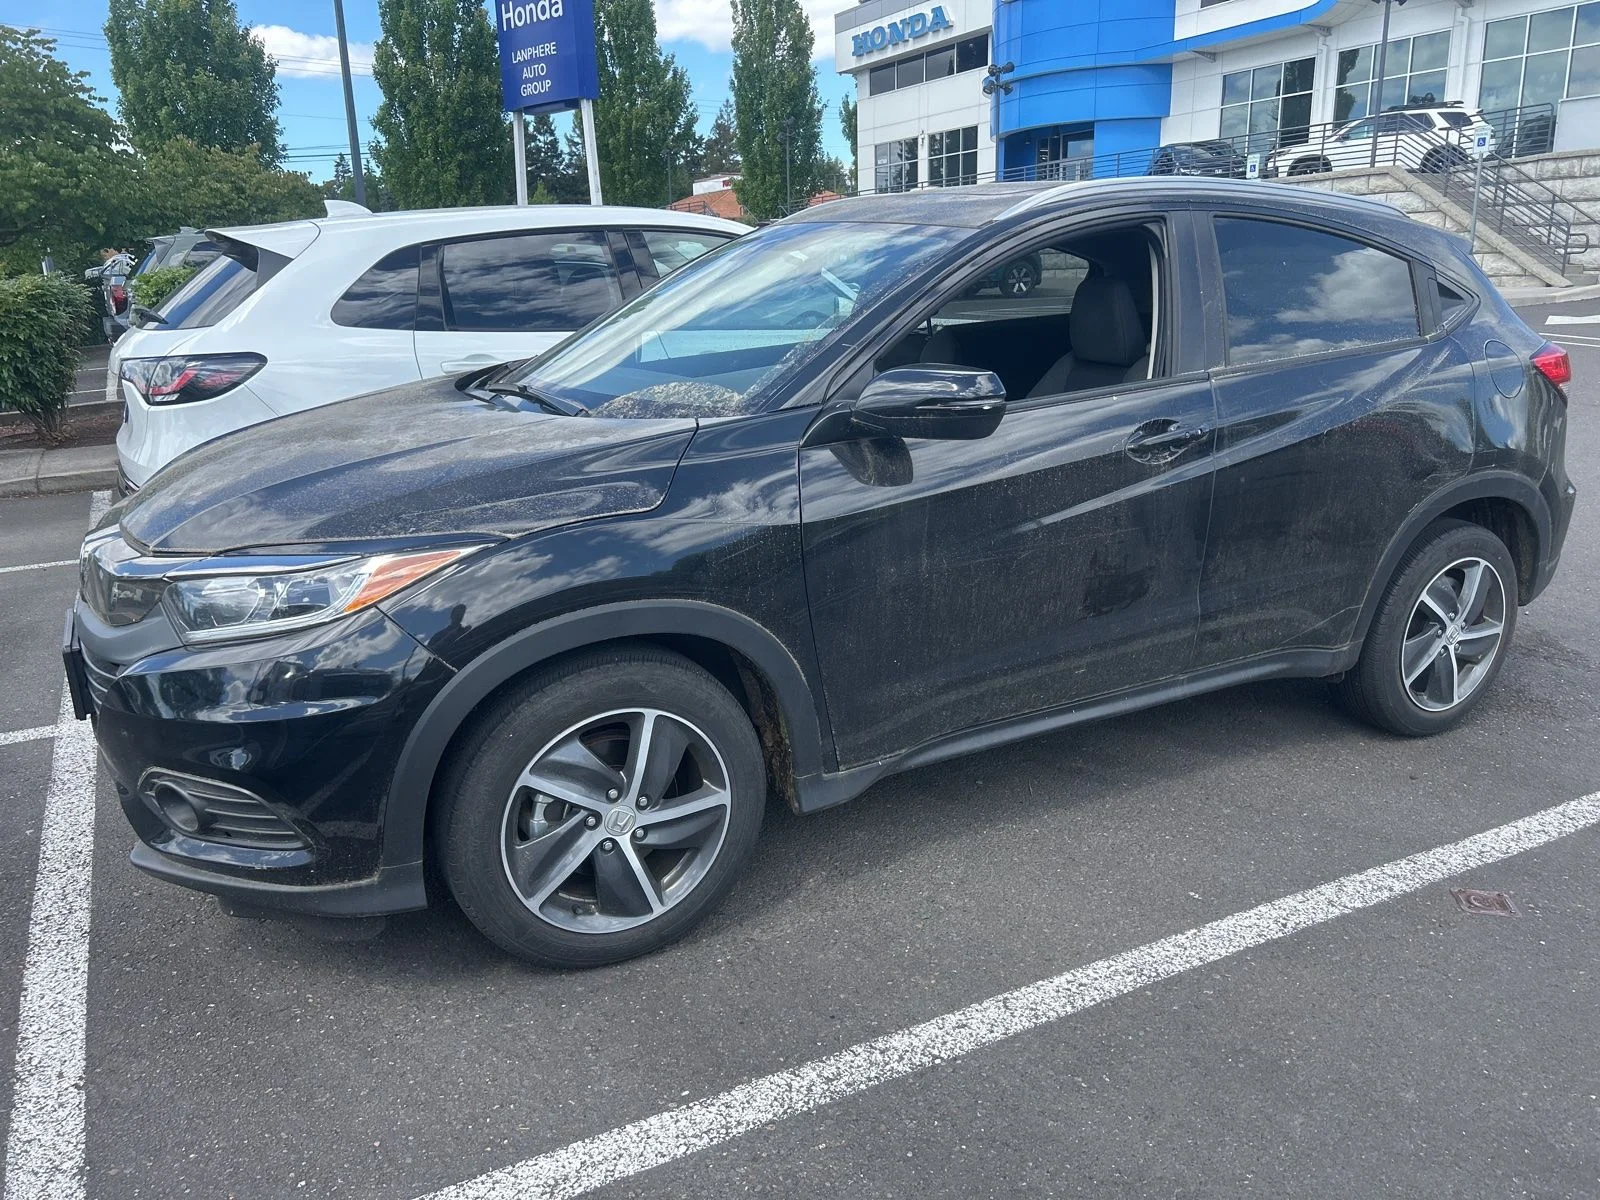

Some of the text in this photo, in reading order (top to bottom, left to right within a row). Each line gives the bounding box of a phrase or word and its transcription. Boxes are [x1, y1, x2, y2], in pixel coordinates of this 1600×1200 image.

[501, 0, 563, 31] Honda
[851, 5, 951, 57] HONDA
[511, 42, 557, 64] LANPHERE
[522, 63, 547, 80] AUTO
[520, 79, 552, 97] GROUP
